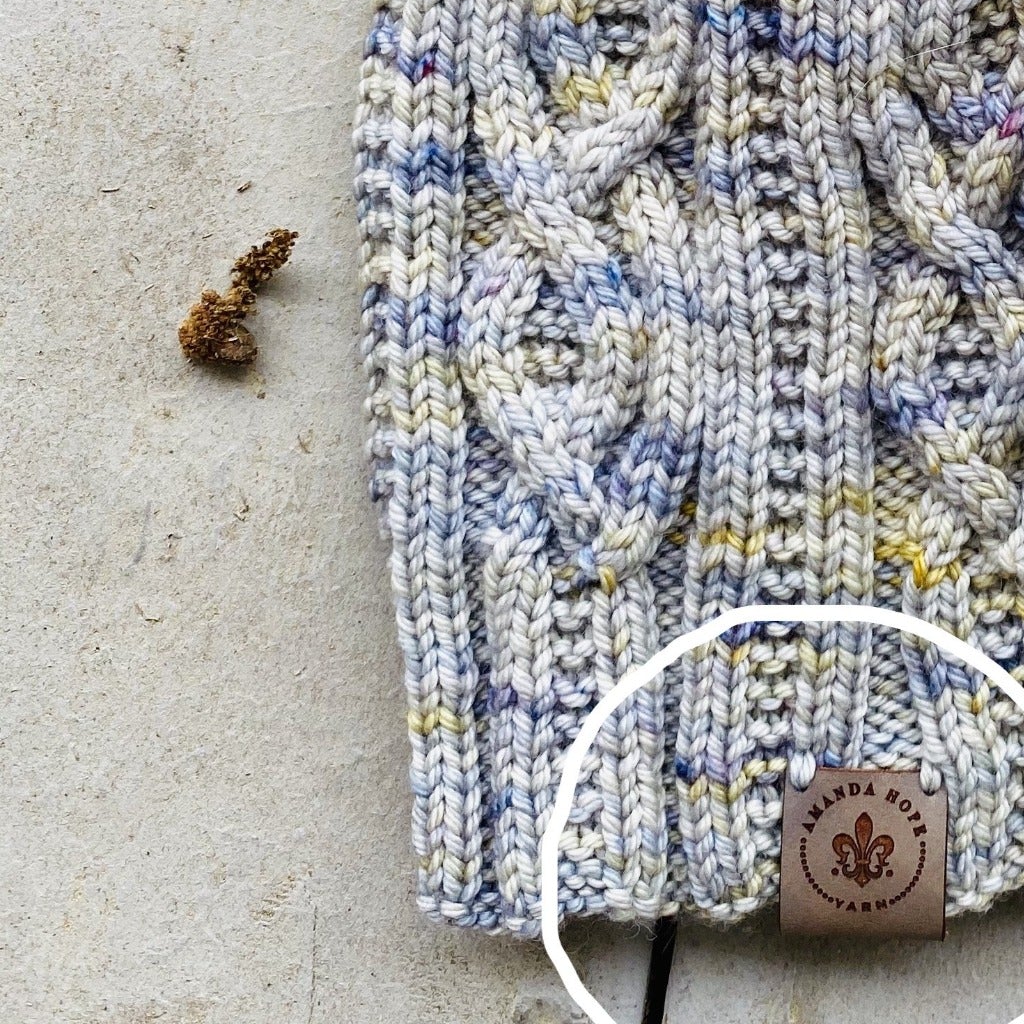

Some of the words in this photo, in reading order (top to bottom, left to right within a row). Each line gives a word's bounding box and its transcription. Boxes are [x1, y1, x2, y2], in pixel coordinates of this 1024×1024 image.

[802, 782, 876, 834] AMANDA
[885, 788, 927, 837] HOPE
[834, 898, 888, 913] YARN
